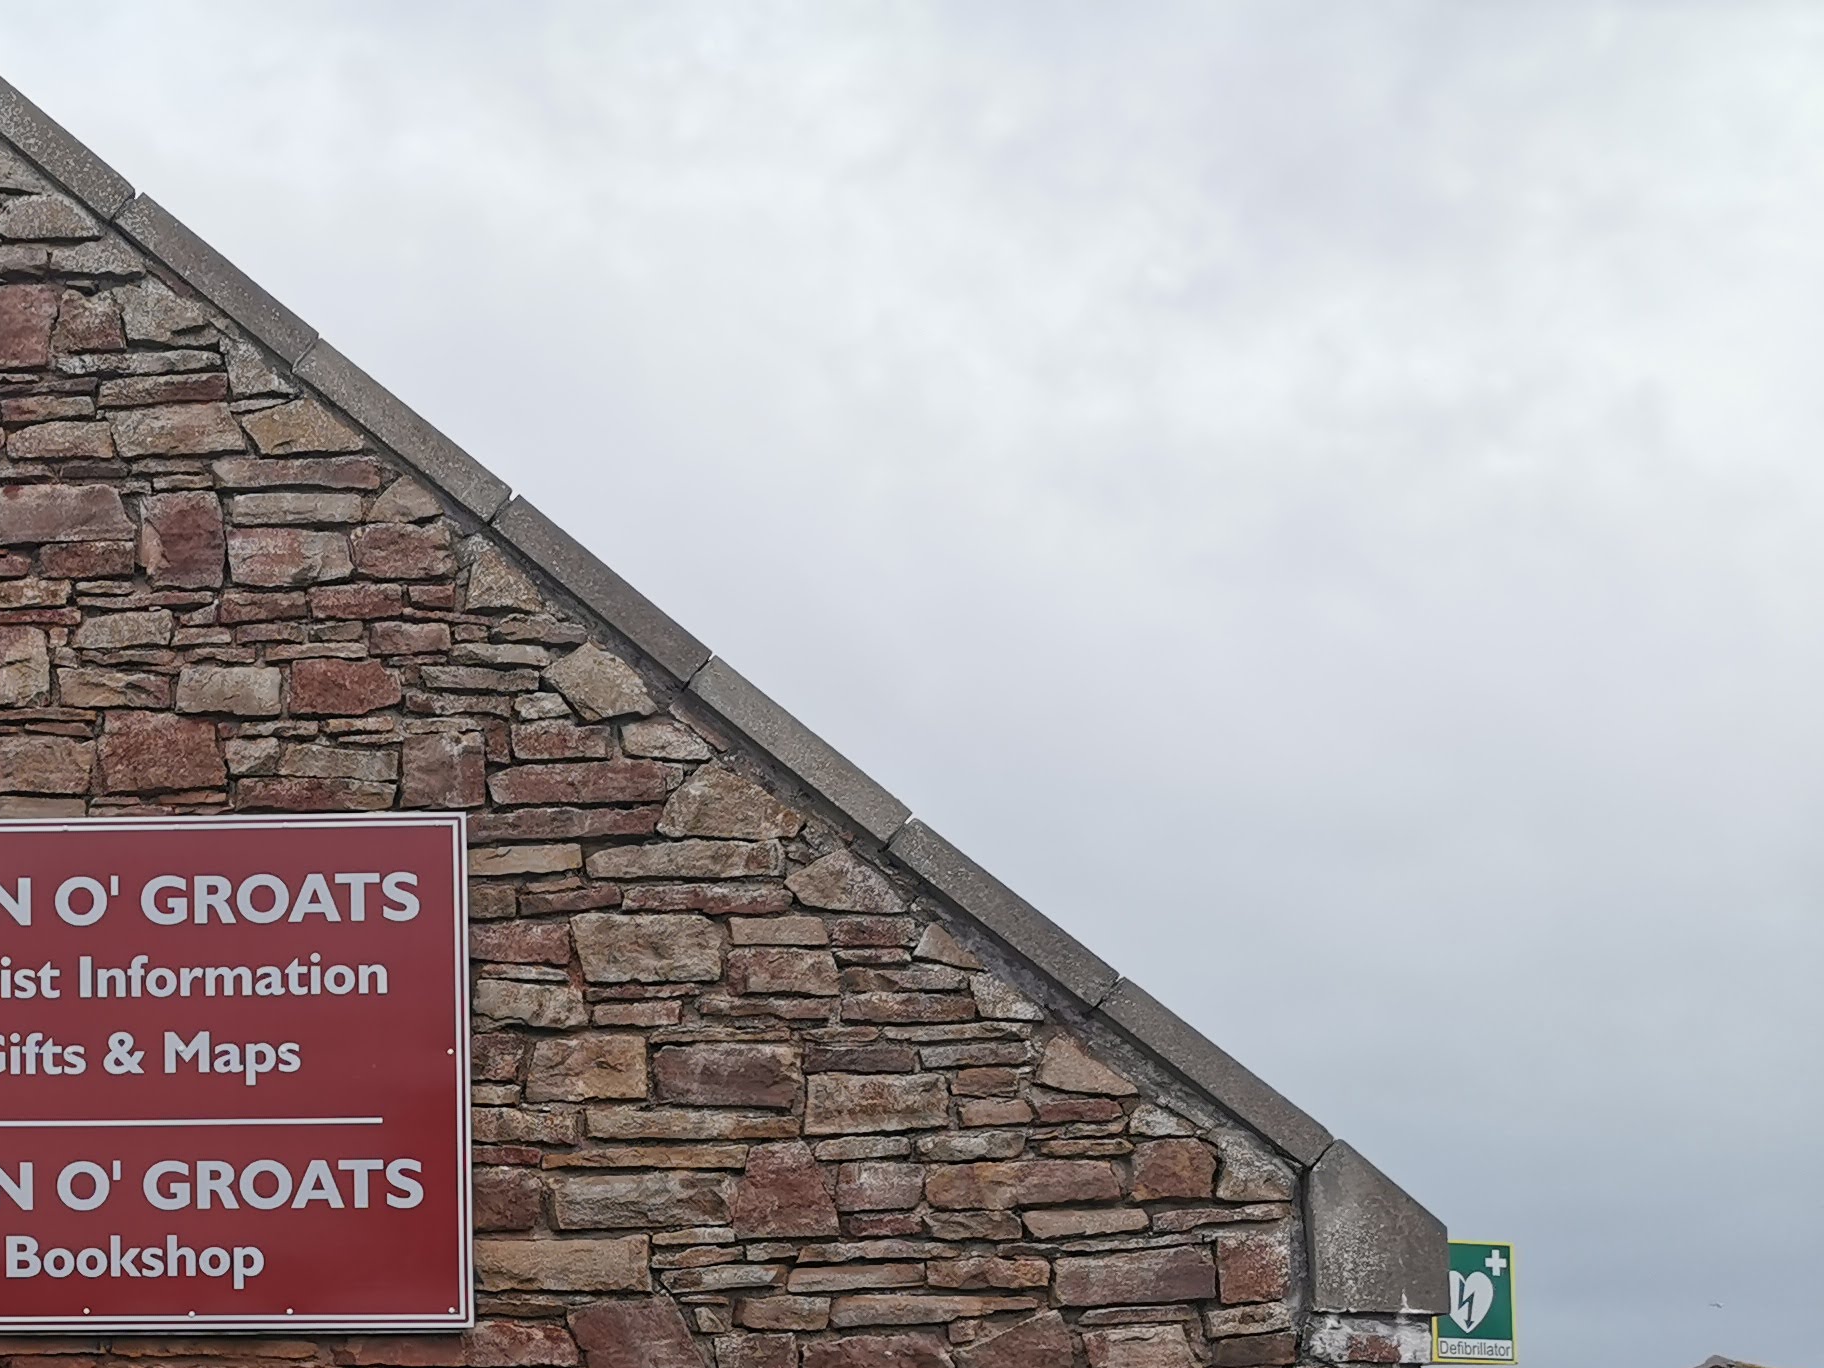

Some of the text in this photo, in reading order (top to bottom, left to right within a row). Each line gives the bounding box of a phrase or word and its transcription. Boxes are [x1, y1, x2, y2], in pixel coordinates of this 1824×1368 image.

[54, 875, 119, 927] O'
[140, 871, 420, 926] GROATS
[79, 952, 388, 998] Information
[103, 1031, 145, 1075] &
[164, 1030, 301, 1086] Maps
[56, 1159, 122, 1211] O'
[142, 1158, 424, 1211] GROATS
[5, 1234, 265, 1290] Bookshop
[1439, 1340, 1511, 1357] Defibrillator
